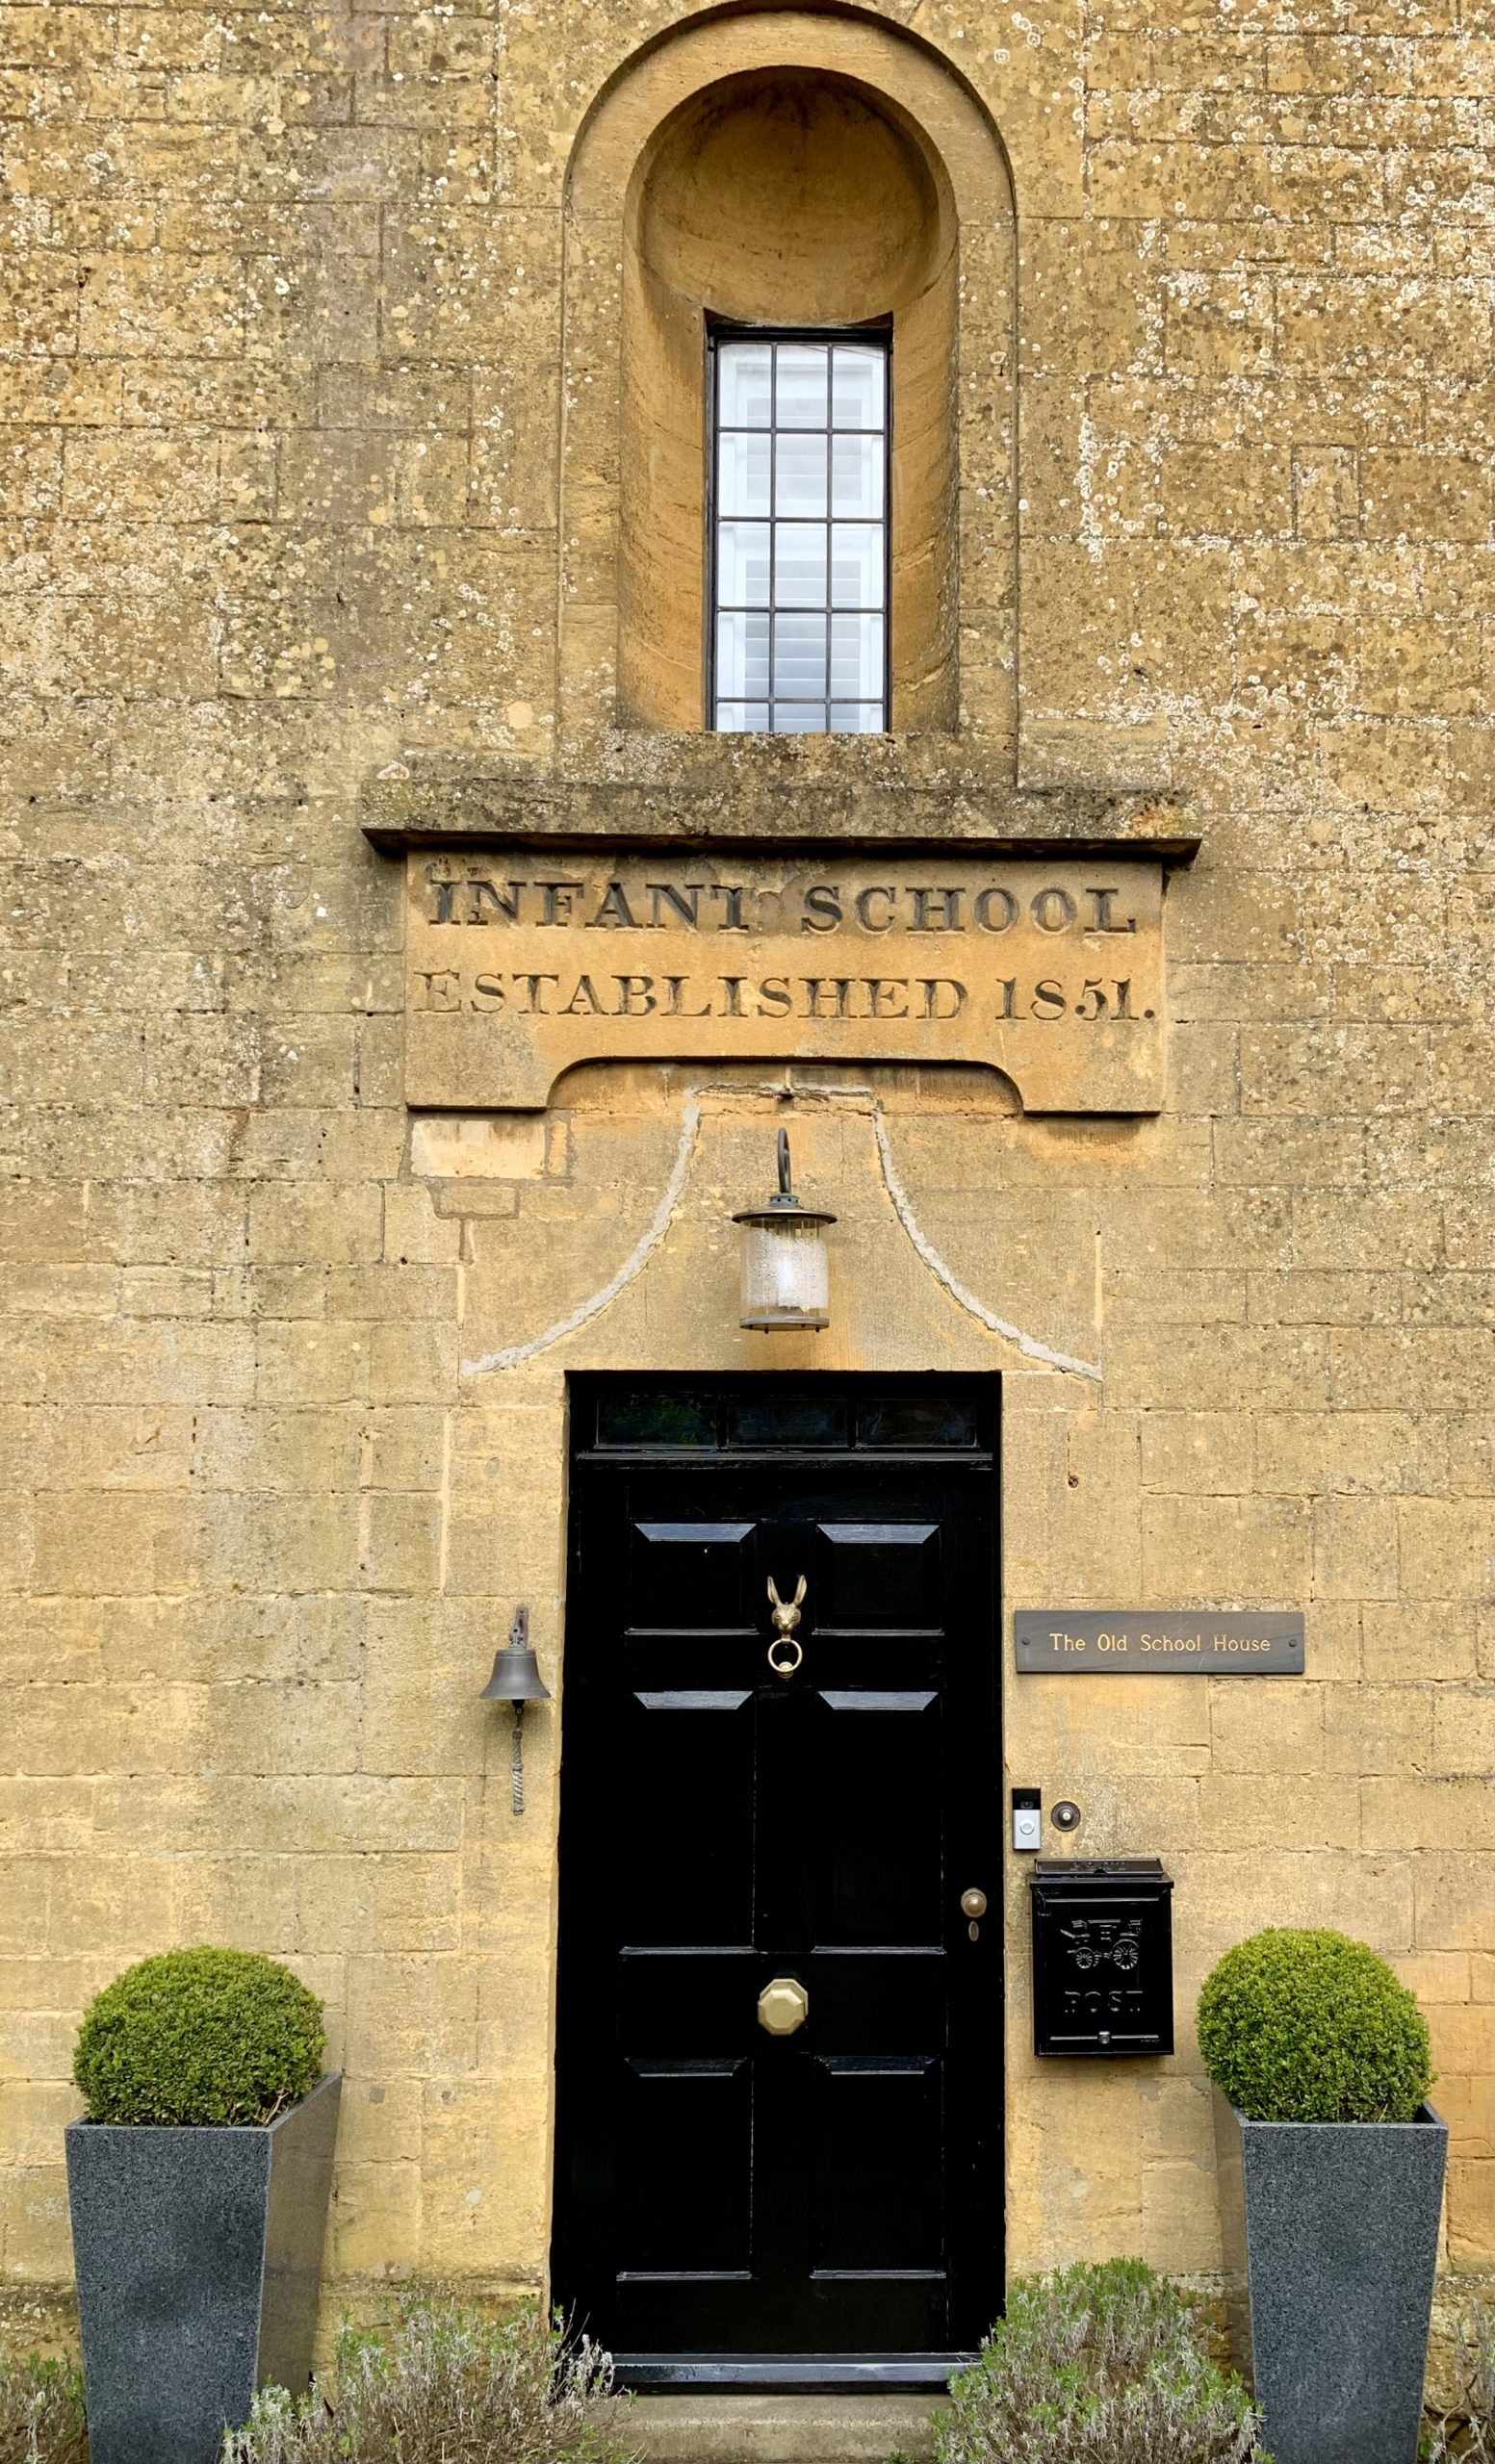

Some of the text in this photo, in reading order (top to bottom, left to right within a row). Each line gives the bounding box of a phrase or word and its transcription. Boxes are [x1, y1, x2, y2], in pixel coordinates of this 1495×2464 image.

[427, 878, 1137, 934] INFANT SCHOOL
[412, 969, 1156, 1021] ESTABLISHED 1851.
[1048, 1632, 1272, 1653] The Old School House
[1064, 1989, 1144, 2014] POST
